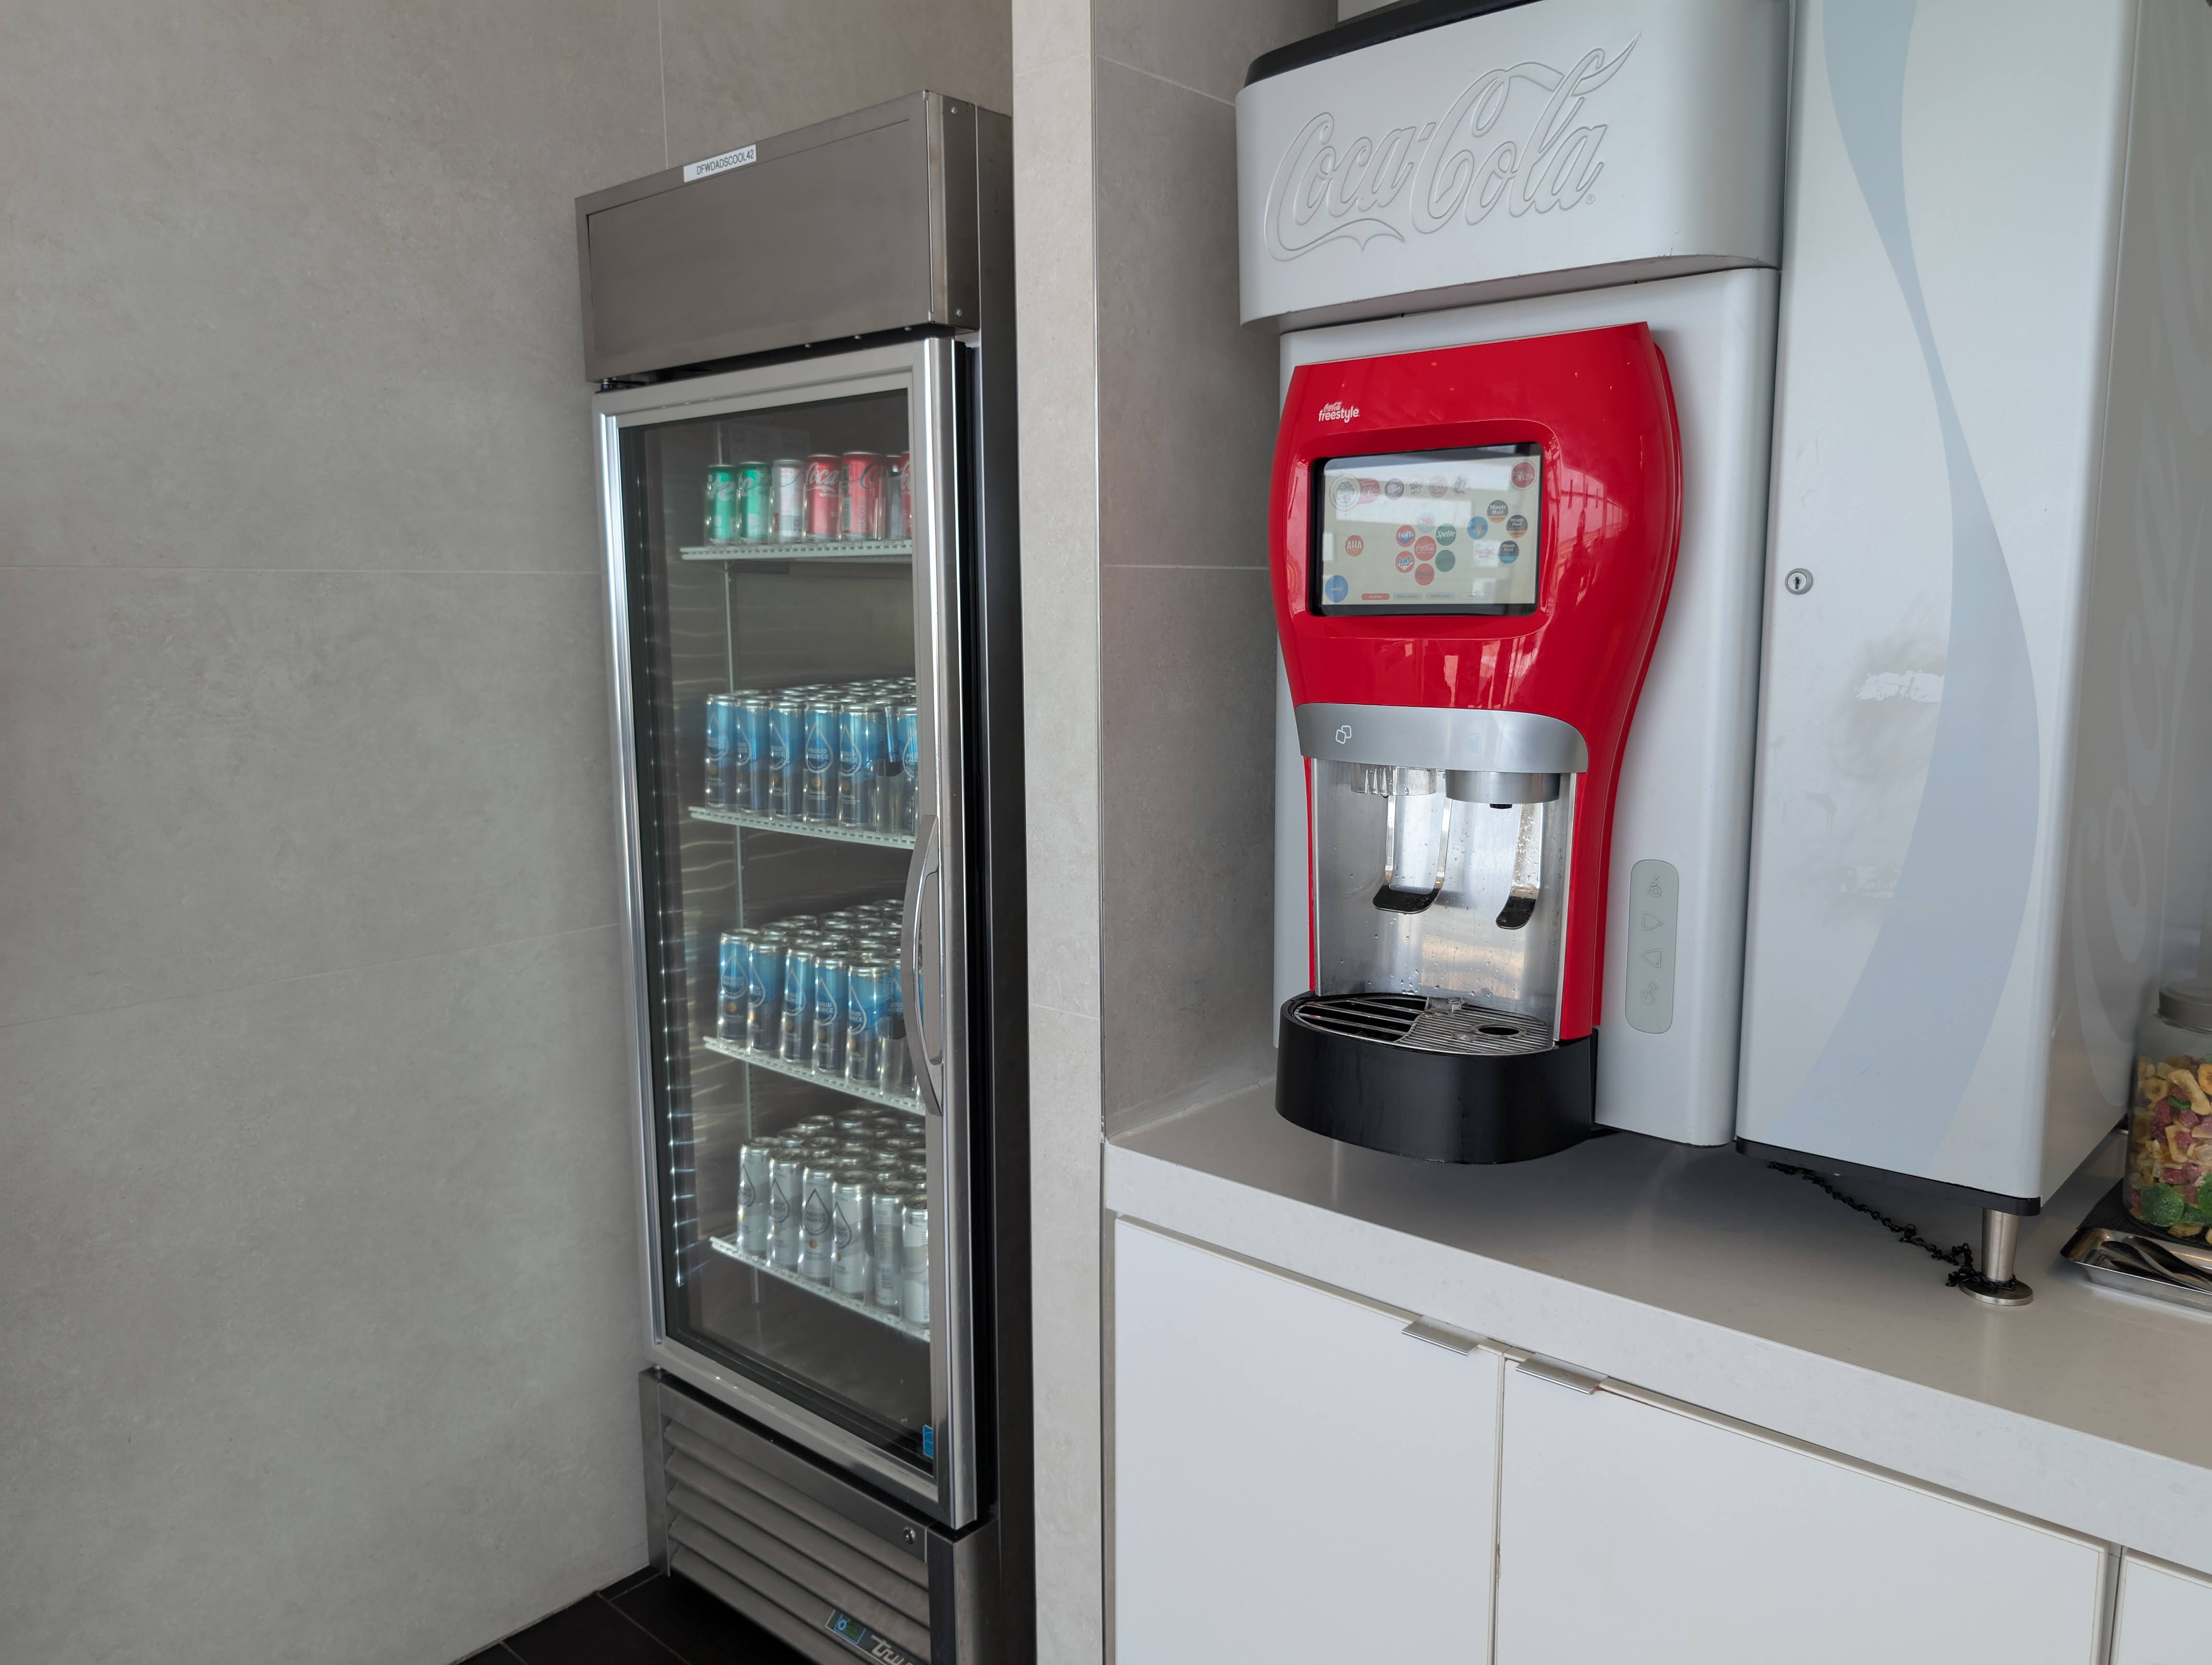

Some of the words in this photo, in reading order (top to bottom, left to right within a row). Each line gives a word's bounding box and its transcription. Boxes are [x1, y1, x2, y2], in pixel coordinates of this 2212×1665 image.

[1264, 33, 1641, 262] Coca-Cola
[697, 149, 754, 175] DFWDADSCOOL42
[1323, 401, 1342, 412] Coca-Cola
[1318, 405, 1359, 423] freestyle
[1398, 531, 1414, 539] FANTA
[1436, 530, 1456, 539] Sprite
[1347, 540, 1362, 549] AHA
[1397, 557, 1413, 566] FANTA
